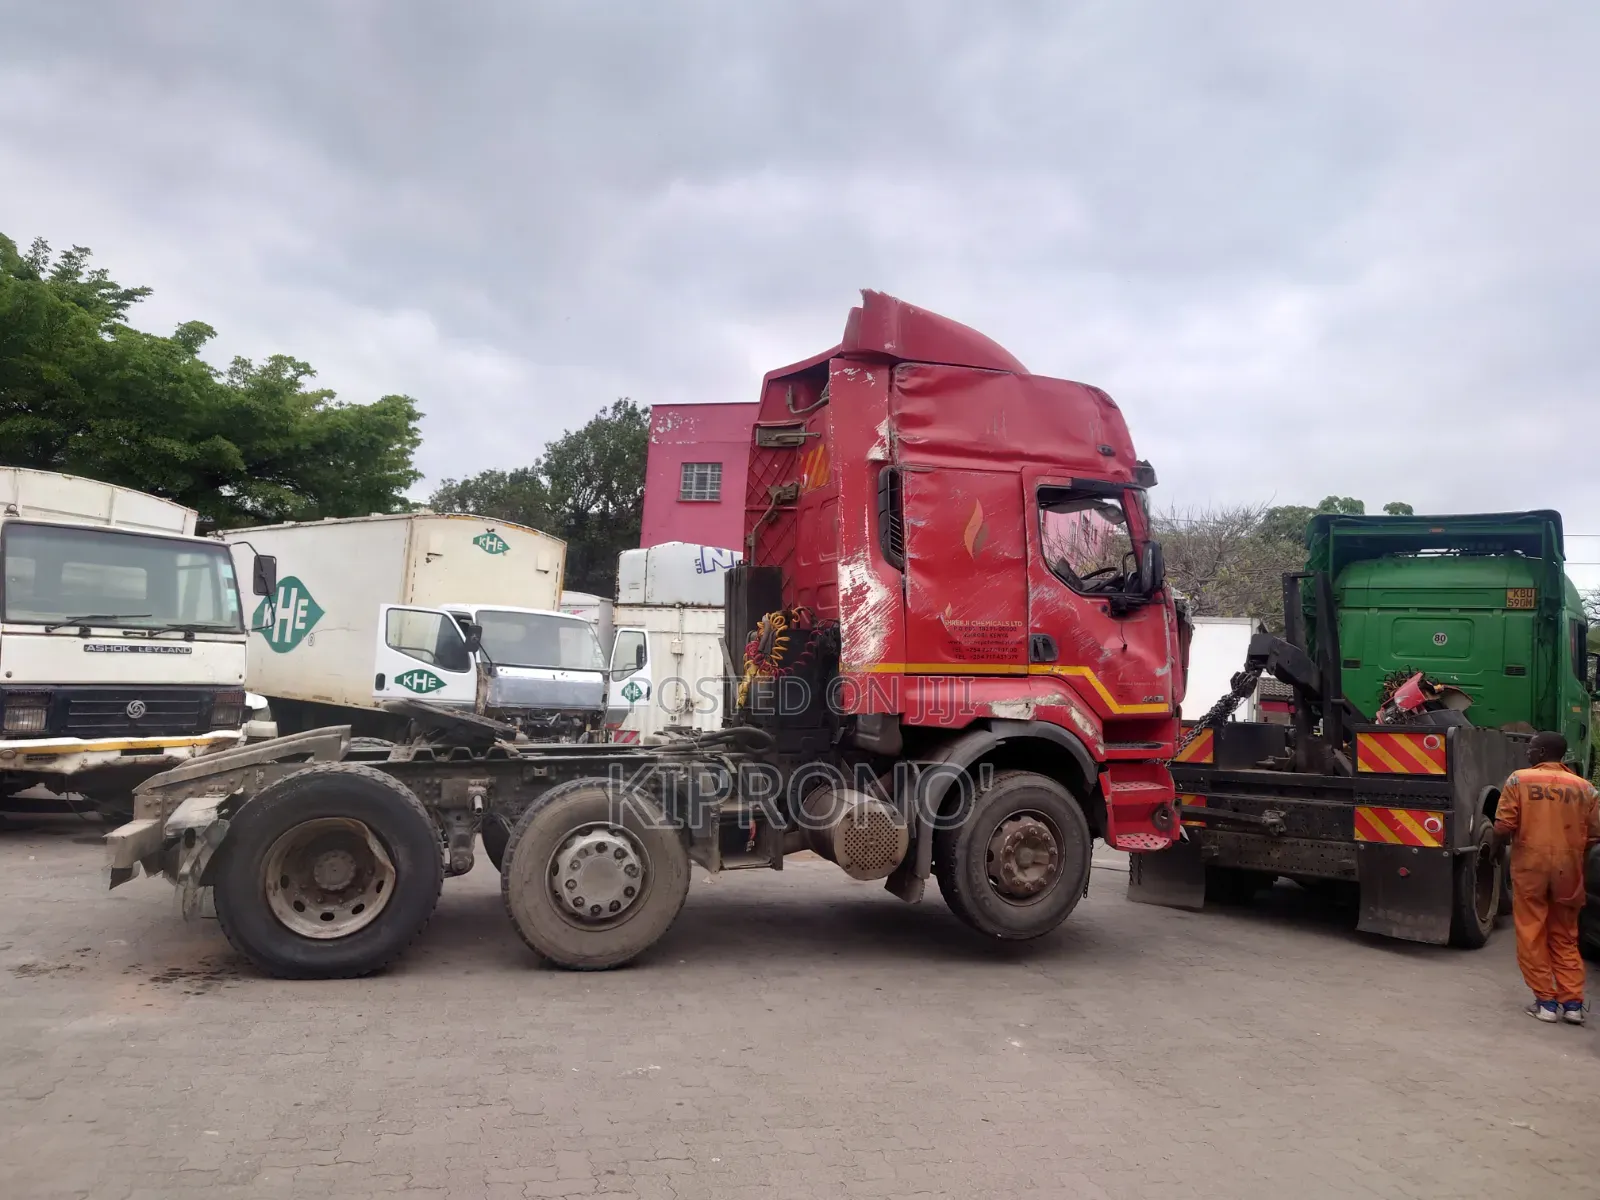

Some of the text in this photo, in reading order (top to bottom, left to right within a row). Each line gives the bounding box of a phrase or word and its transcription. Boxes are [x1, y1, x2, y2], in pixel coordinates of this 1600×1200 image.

[479, 536, 504, 552] KHE
[694, 558, 703, 575] LTD
[1512, 589, 1533, 598] KBU
[262, 587, 309, 643] KHE
[971, 619, 1010, 627] CHEMICALS
[1434, 634, 1447, 642] 80
[138, 646, 192, 654] LEYLAND
[403, 673, 437, 691] KHE
[624, 684, 640, 700] KHE
